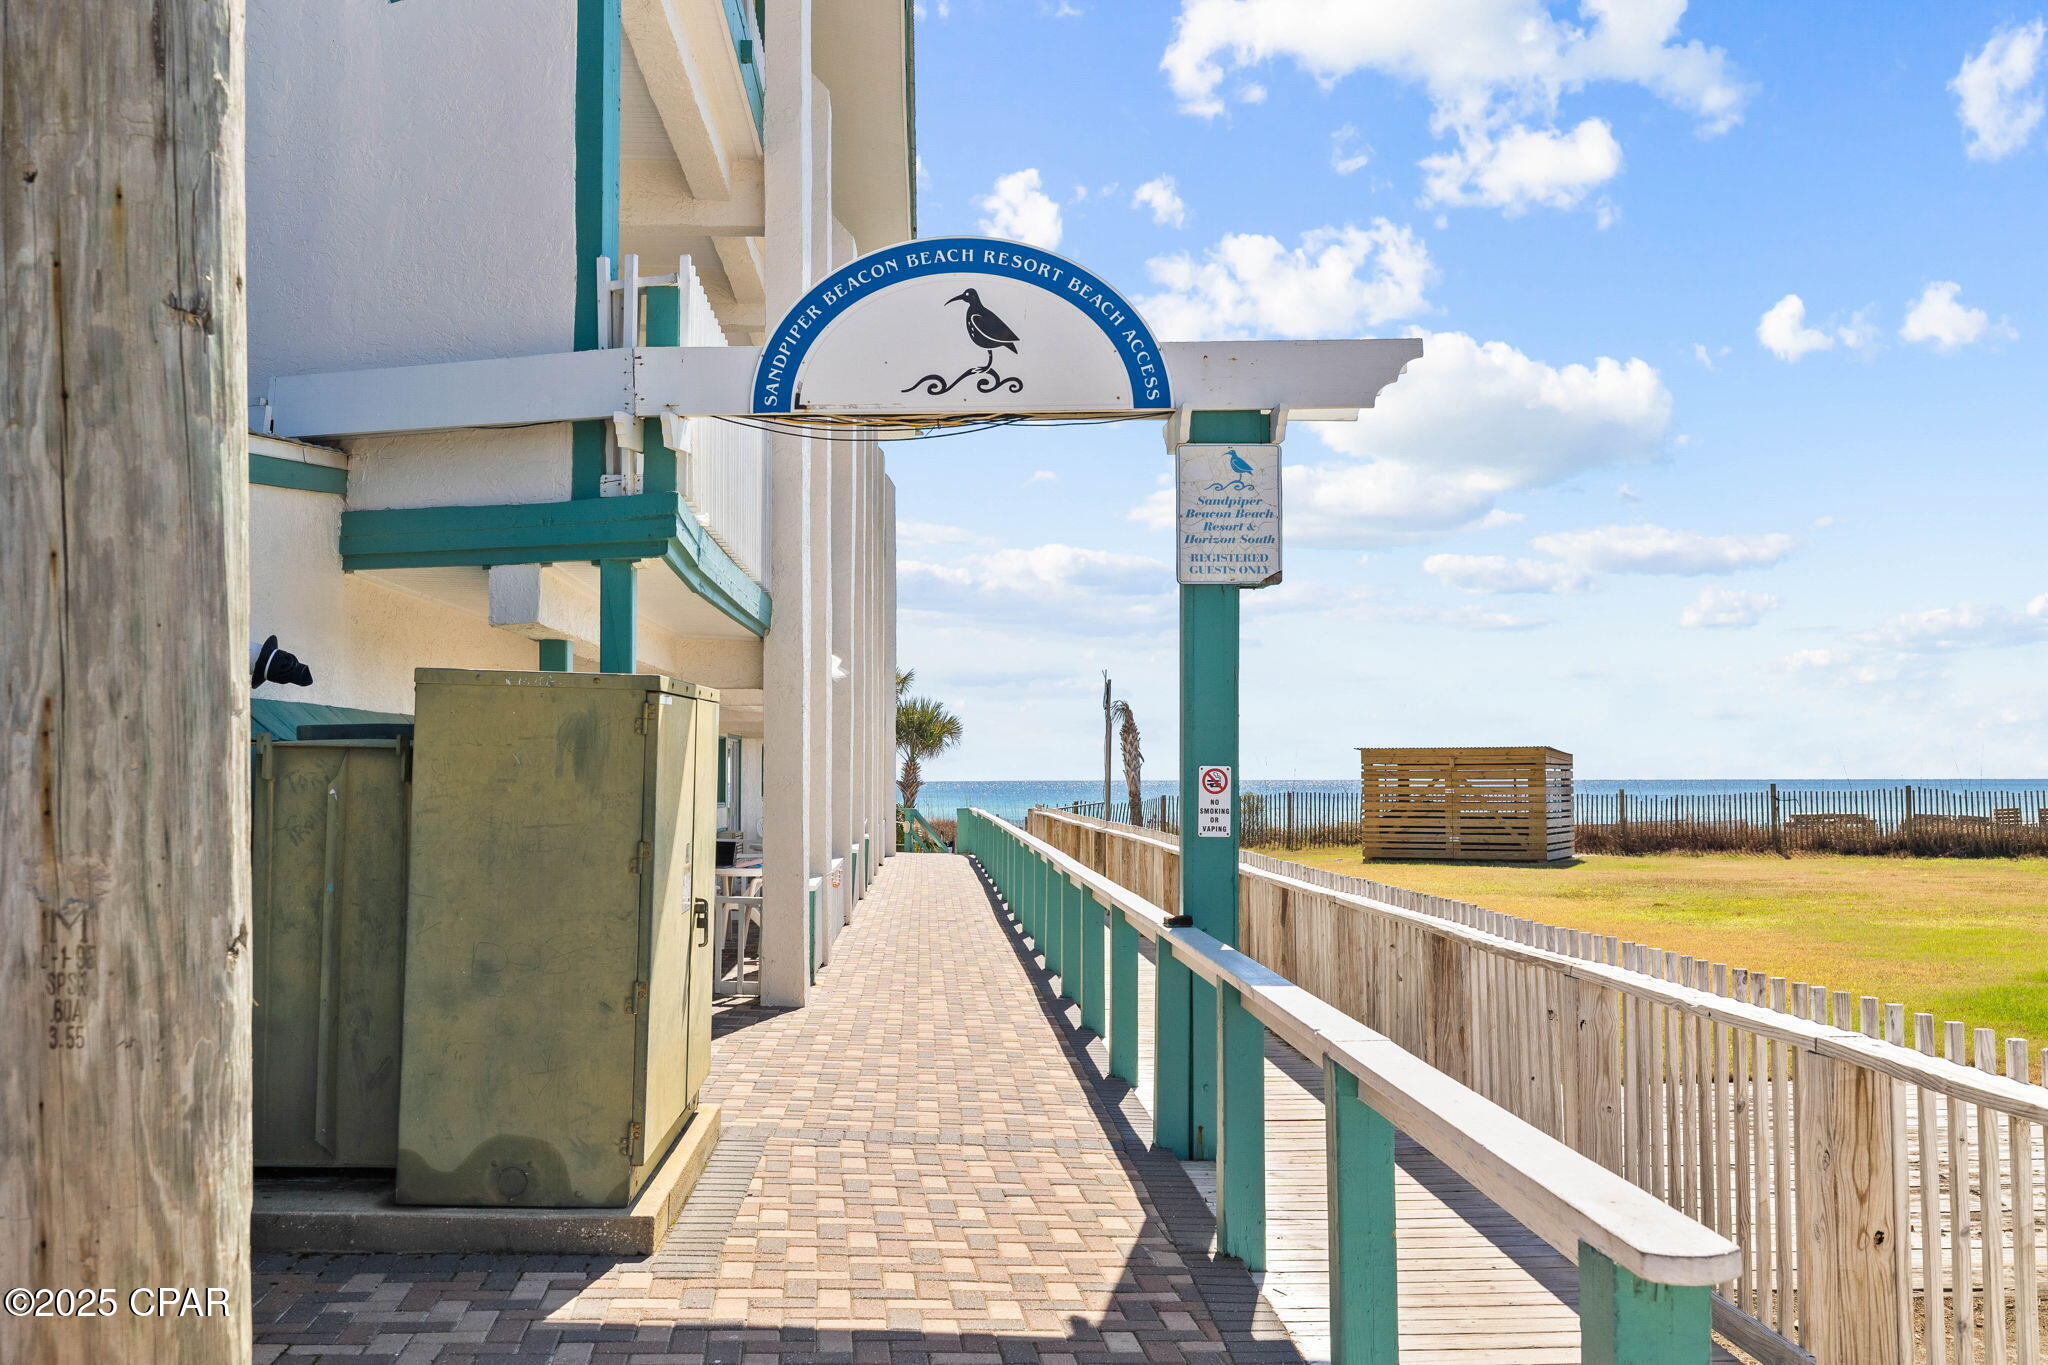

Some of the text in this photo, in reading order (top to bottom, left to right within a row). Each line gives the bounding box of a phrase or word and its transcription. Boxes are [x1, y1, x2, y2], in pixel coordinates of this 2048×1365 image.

[764, 248, 1160, 407] SANDPIPER BEACON BEACH RESORT BEACH ACCESS
[1196, 496, 1263, 508] Sandpiper
[1185, 508, 1274, 519] Beacon Beach
[1202, 521, 1257, 531] Resort &
[1184, 534, 1276, 544] Horizon South
[1189, 553, 1269, 563] REGISTERED
[1188, 565, 1270, 574] GUESTS ONLY
